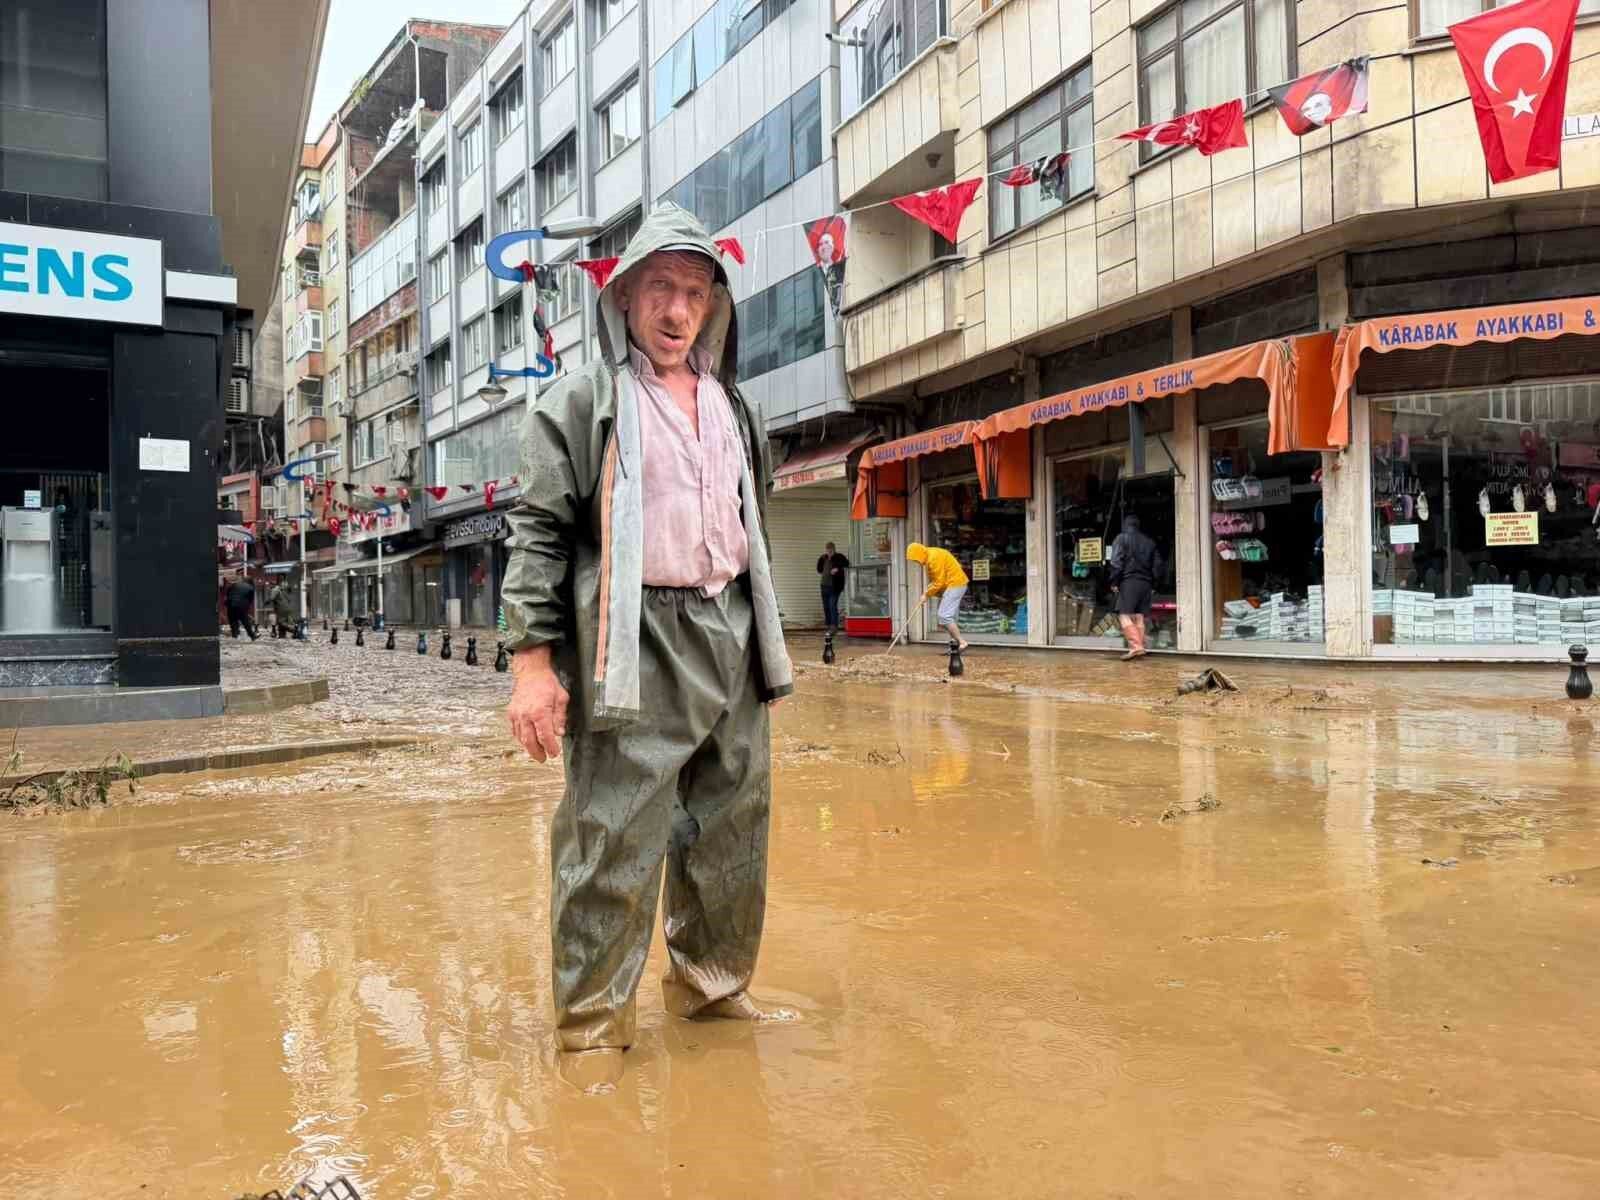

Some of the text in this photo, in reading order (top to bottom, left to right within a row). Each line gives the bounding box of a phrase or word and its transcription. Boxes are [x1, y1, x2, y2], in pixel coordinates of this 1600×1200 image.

[0, 243, 133, 302] ENS
[1476, 311, 1564, 338] AYAKKABI
[1583, 308, 1596, 328] &
[1079, 385, 1129, 409] AYAKKABI
[1136, 381, 1144, 396] &
[1152, 368, 1194, 393] TERLİK
